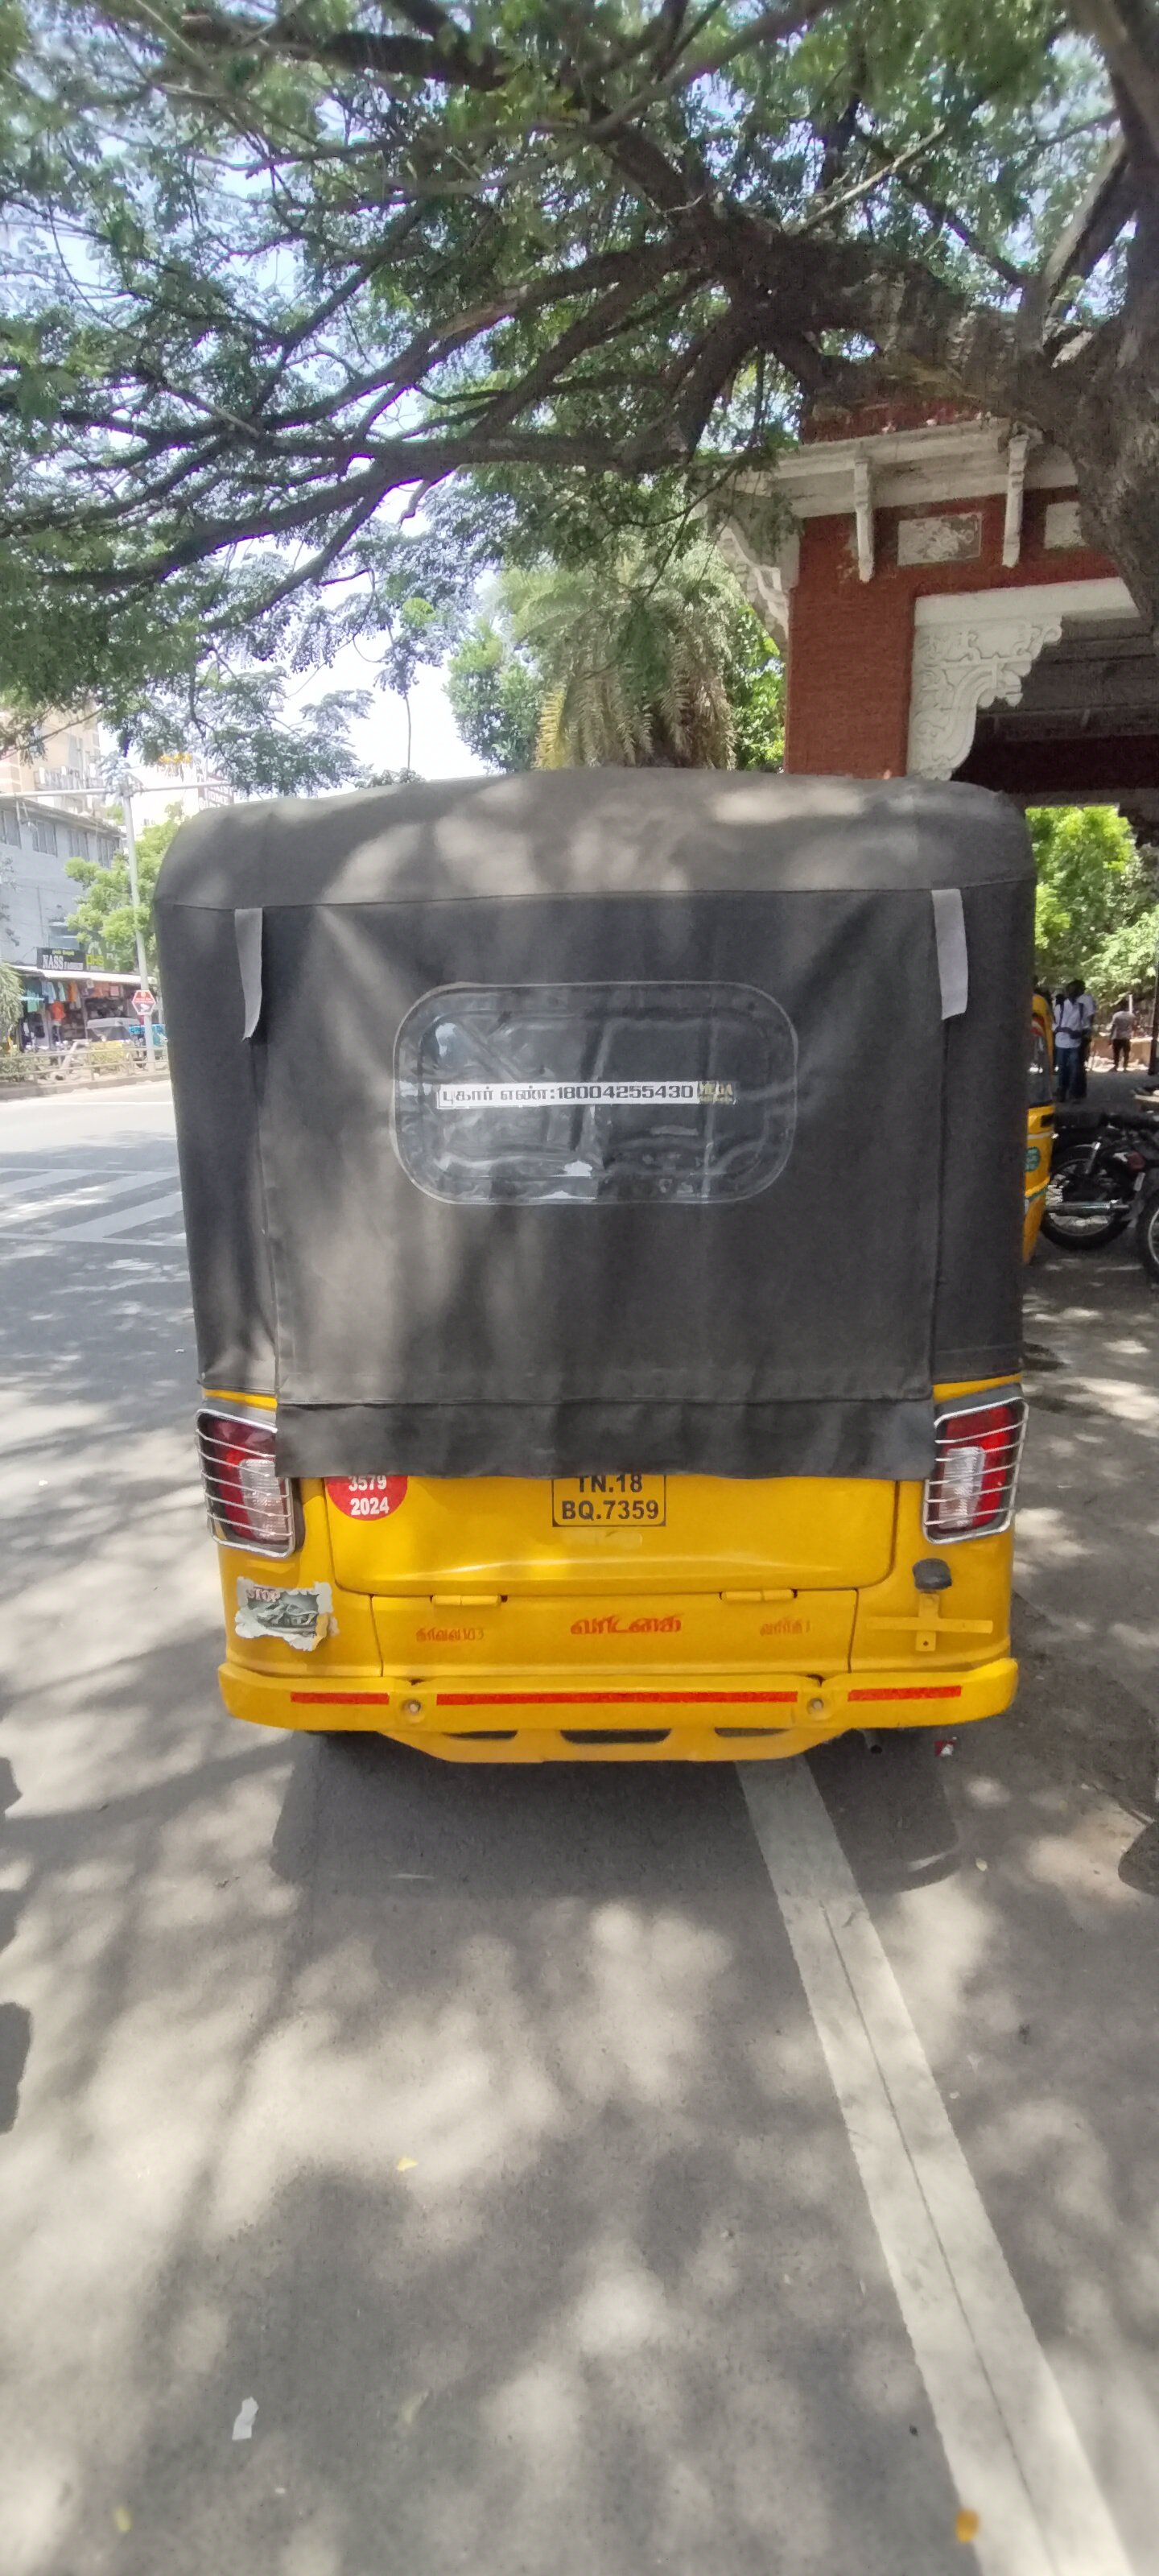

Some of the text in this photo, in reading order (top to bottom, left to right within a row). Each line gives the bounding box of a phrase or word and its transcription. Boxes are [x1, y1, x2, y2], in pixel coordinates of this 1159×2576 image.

[443, 1086, 493, 1104] புகார்
[349, 1475, 387, 1492] 3579
[579, 1474, 643, 1492] TN.18
[349, 1496, 390, 1516] 2024
[562, 1500, 659, 1521] BQ.7359
[245, 1588, 281, 1603] STOP
